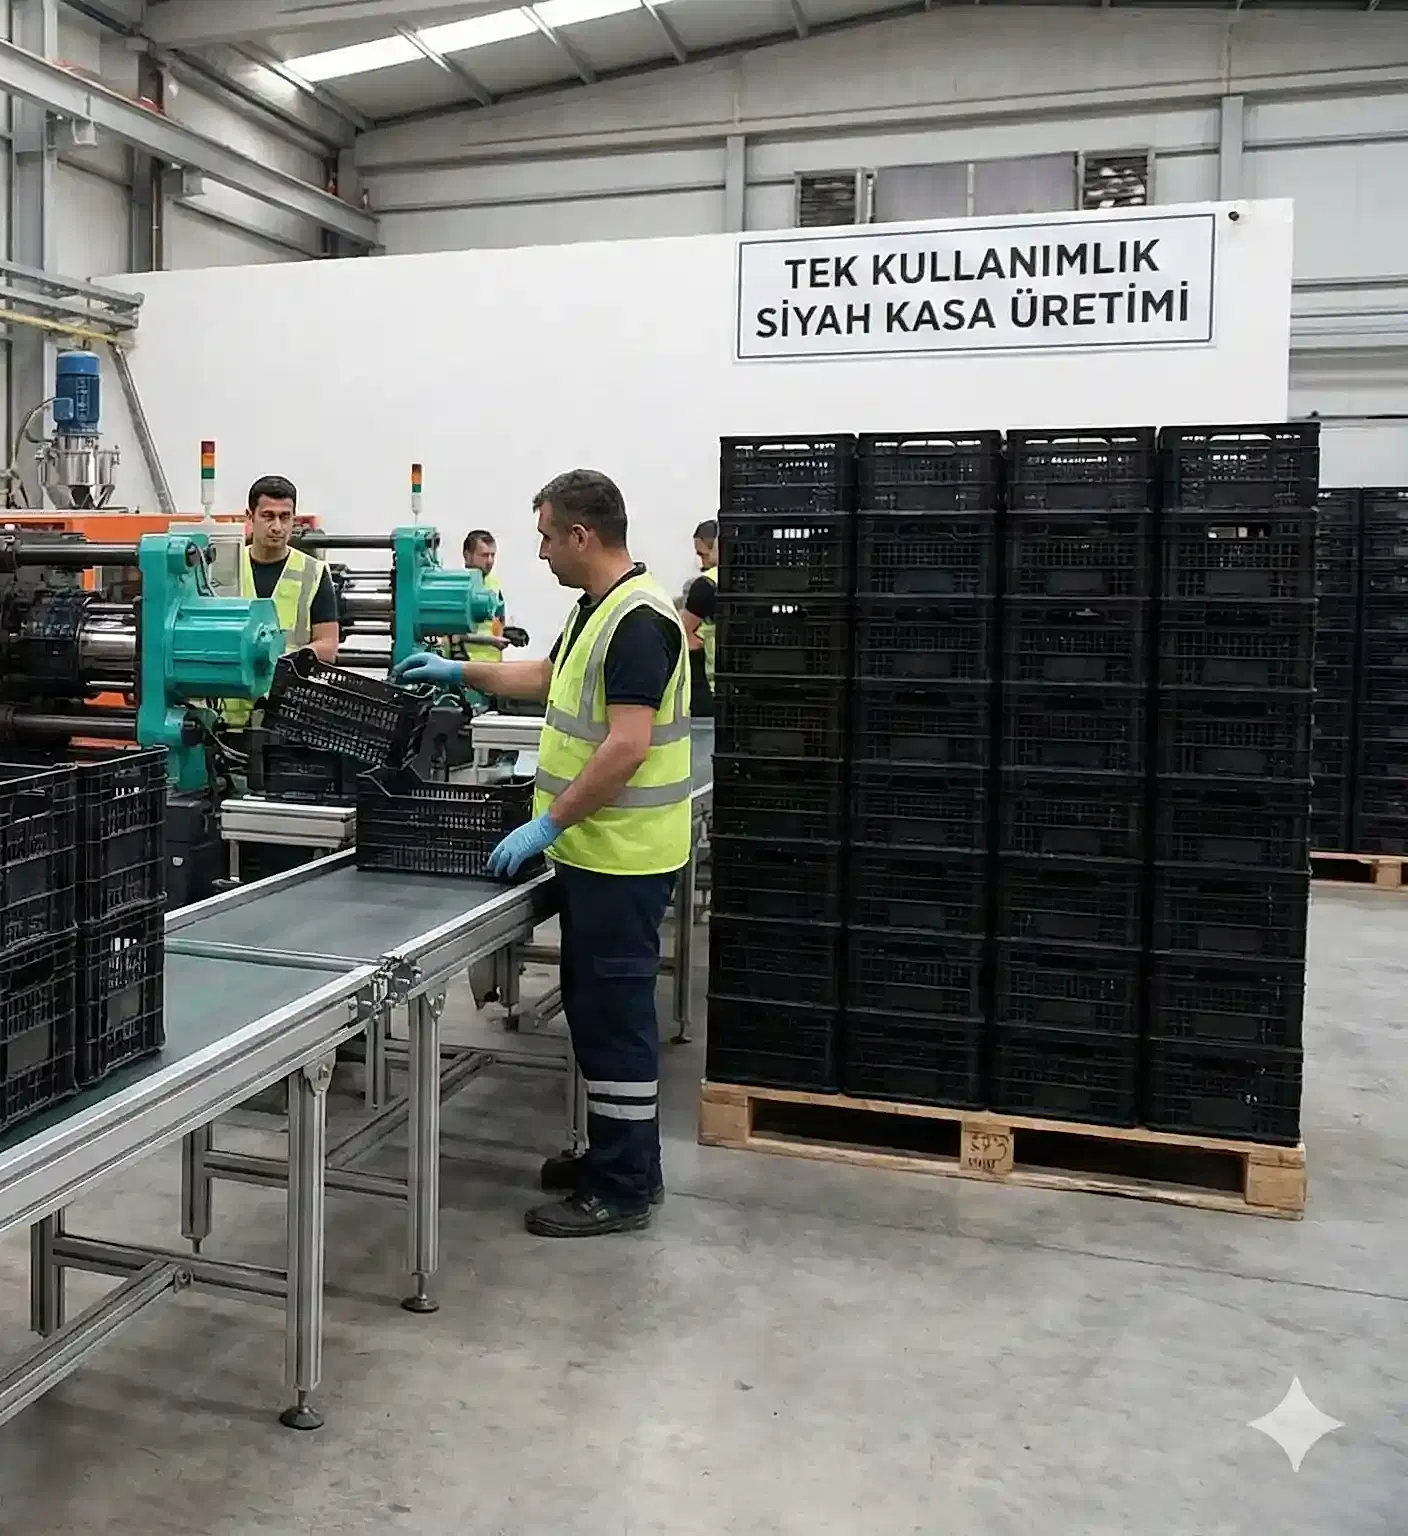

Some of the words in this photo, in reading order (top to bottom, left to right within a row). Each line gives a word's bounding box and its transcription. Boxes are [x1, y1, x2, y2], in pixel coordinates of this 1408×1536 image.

[784, 257, 858, 289] TEK
[872, 238, 1160, 286] KULLANIMLIK
[755, 298, 871, 339] SİYAH
[886, 296, 997, 333] KASA
[1011, 280, 1188, 328] ÜRETİMİ
